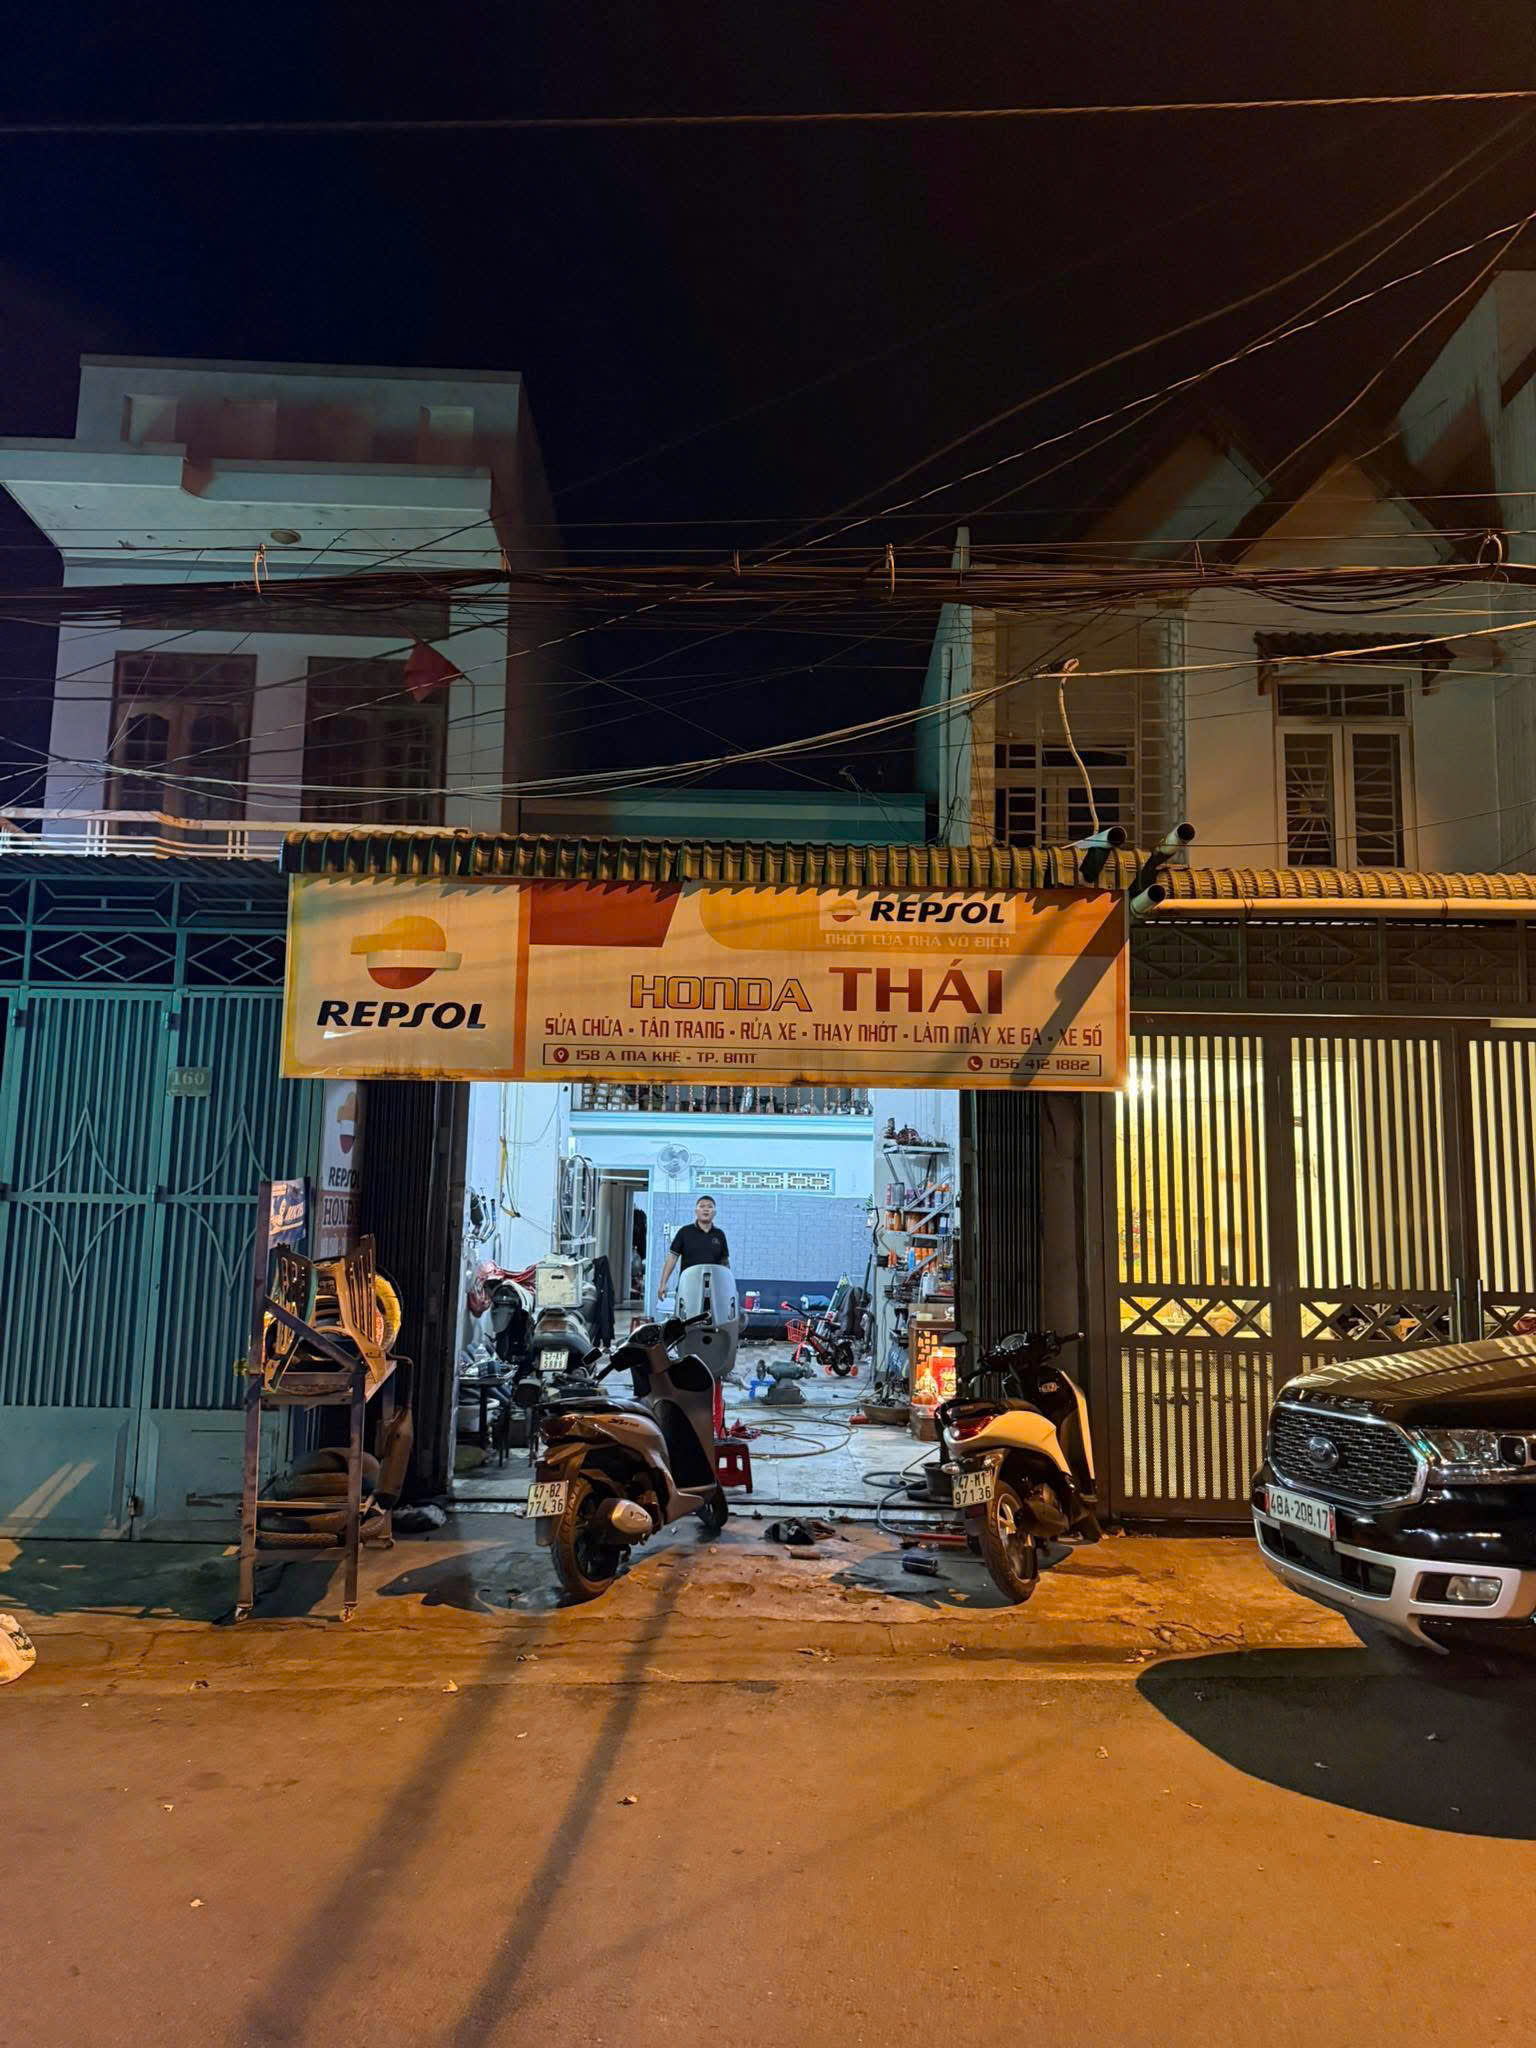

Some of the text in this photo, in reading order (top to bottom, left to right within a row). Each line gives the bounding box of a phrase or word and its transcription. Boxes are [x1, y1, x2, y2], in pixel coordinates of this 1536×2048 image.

[869, 900, 1005, 924] REPSOL
[630, 959, 1003, 1014] HONDA THÁI
[316, 1000, 487, 1029] REPSOL
[544, 1013, 1102, 1047] SỬA CHỮA TÂN TRANG RỬA XE THAY NHỚT LÀM MÁY XE GA XE SỐ
[575, 1049, 600, 1061] 158
[605, 1050, 616, 1061] A
[621, 1050, 647, 1062] MA
[696, 1051, 719, 1063] TP.
[724, 1052, 758, 1064] BMT
[990, 1057, 1090, 1071] 056 412 1882
[171, 1072, 205, 1086] 160
[954, 1486, 992, 1505] 971.36
[529, 1499, 564, 1516] 774.36
[1270, 1493, 1329, 1532] 48A-208.17
